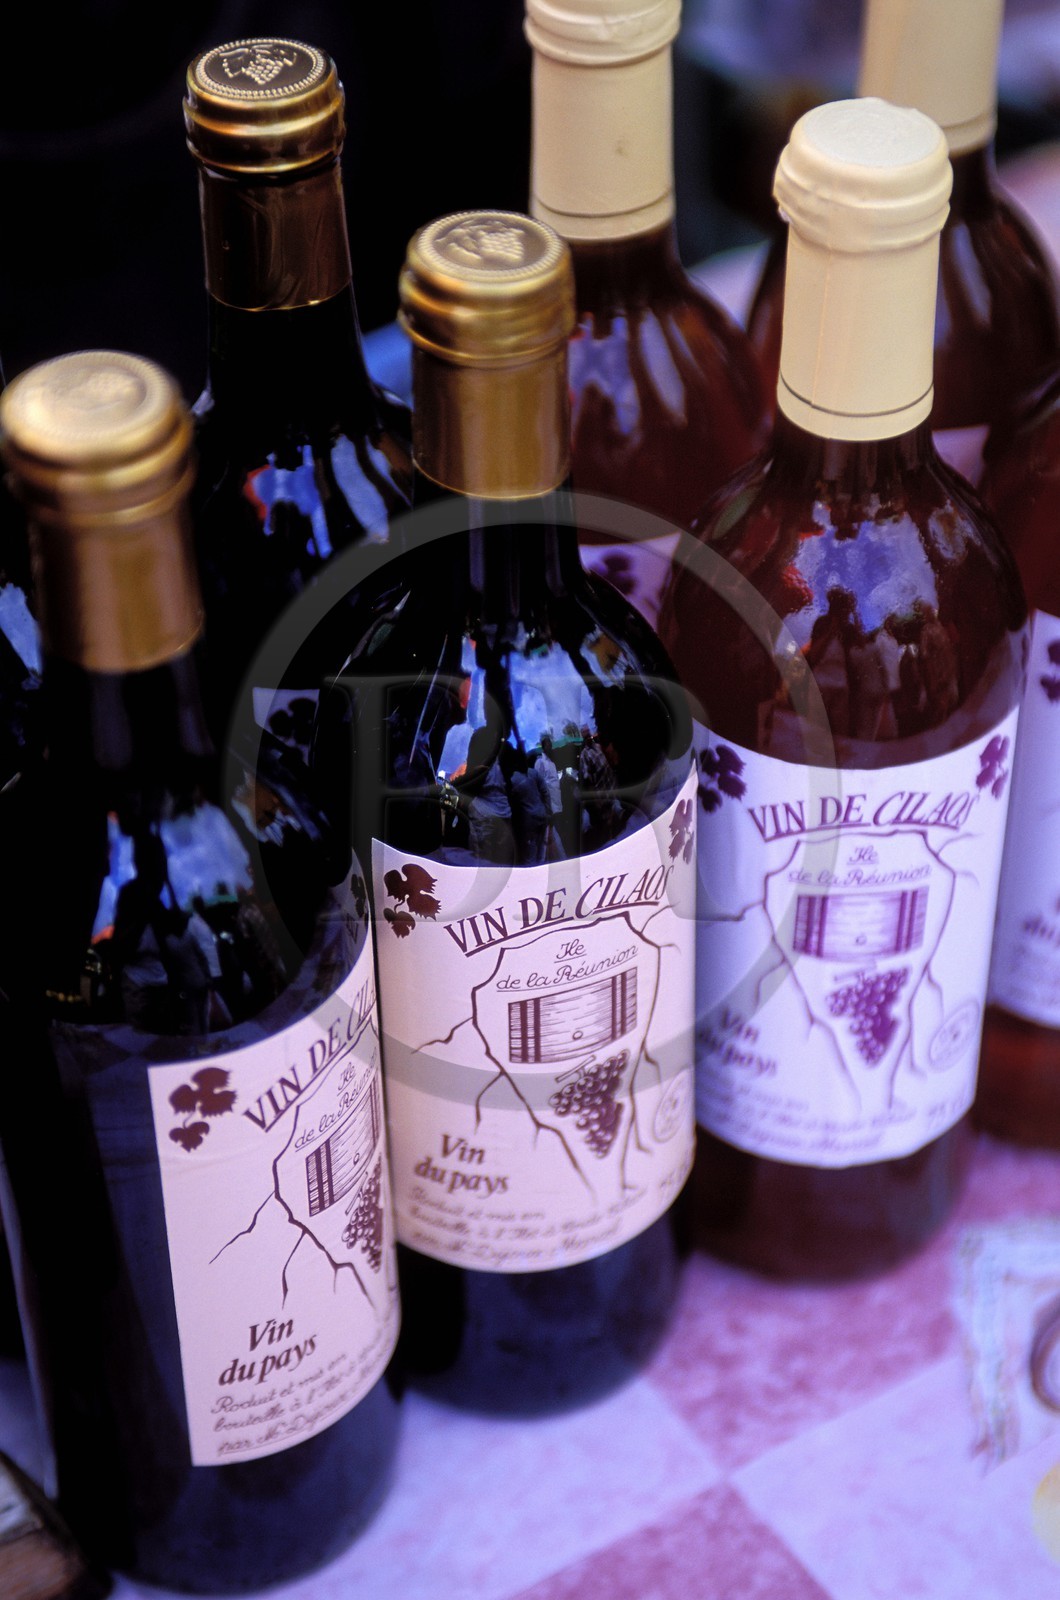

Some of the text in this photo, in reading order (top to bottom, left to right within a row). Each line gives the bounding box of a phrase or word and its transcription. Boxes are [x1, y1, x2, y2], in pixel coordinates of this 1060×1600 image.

[747, 790, 981, 840] VIN DE CILAOS
[443, 864, 674, 953] VIN DE CILAOS
[496, 945, 638, 990] de la Réunion
[243, 1064, 302, 1131] VIN
[308, 1017, 341, 1075] DE
[295, 1129, 316, 1149] de
[319, 1113, 337, 1133] la
[441, 1133, 486, 1166] Vin
[414, 1156, 509, 1200] du pays
[249, 1318, 294, 1352] Vin
[218, 1357, 257, 1386] du
[255, 1334, 318, 1386] pays
